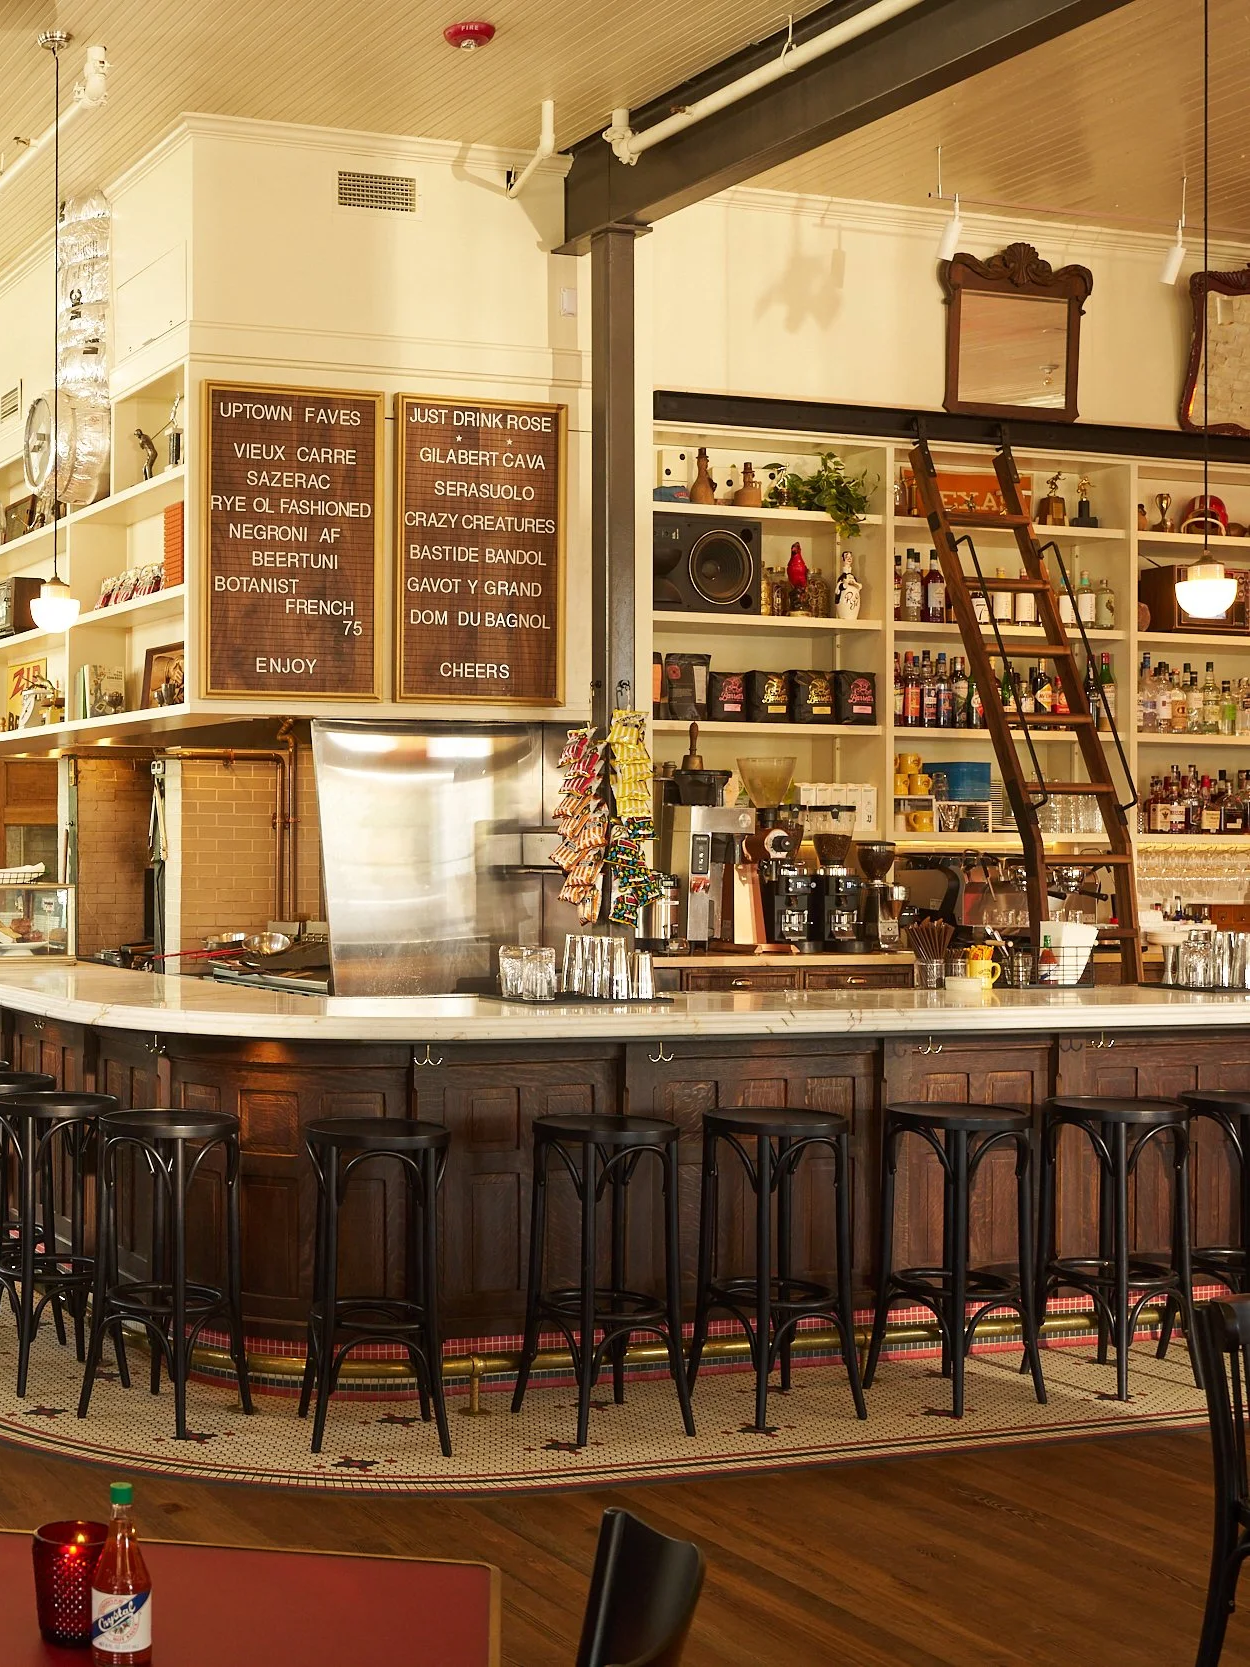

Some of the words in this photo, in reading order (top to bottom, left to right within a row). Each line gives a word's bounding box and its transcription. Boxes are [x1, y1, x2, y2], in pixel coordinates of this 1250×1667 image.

[221, 402, 292, 421] UPTOWN
[306, 408, 360, 425] FAVES
[410, 408, 448, 424] JUST
[454, 411, 503, 428] DRINK
[507, 415, 551, 432] ROSE
[234, 443, 285, 460] VIEUX
[297, 447, 356, 464] CARRE
[420, 447, 499, 466] GILABERT
[503, 453, 545, 470] CAVA
[247, 471, 330, 489] SAZERAC
[434, 481, 534, 500] SERASUOLO
[211, 495, 246, 511] RYE
[253, 498, 274, 513] OL
[281, 499, 371, 517] FASHIONED
[405, 511, 458, 528] CRAZY
[462, 515, 555, 533] CREATURES
[230, 523, 307, 542] NEGRONI
[319, 528, 340, 543] AF
[253, 551, 337, 569] BEERTUNI
[410, 545, 479, 562] BASTIDE
[486, 548, 546, 565] BANDOL
[215, 576, 299, 594] BOTANIST
[407, 577, 461, 593] GAVOT
[468, 580, 478, 594] Y
[484, 581, 541, 596] GRAND
[286, 599, 353, 616] FRENCH
[343, 621, 362, 636] 75
[411, 610, 447, 625] DOM
[458, 611, 480, 626] DU
[485, 612, 550, 629] BAGNOL
[256, 658, 316, 674] ENJOY
[440, 662, 509, 678] CHEERS
[98, 1600, 136, 1632] Crystal
